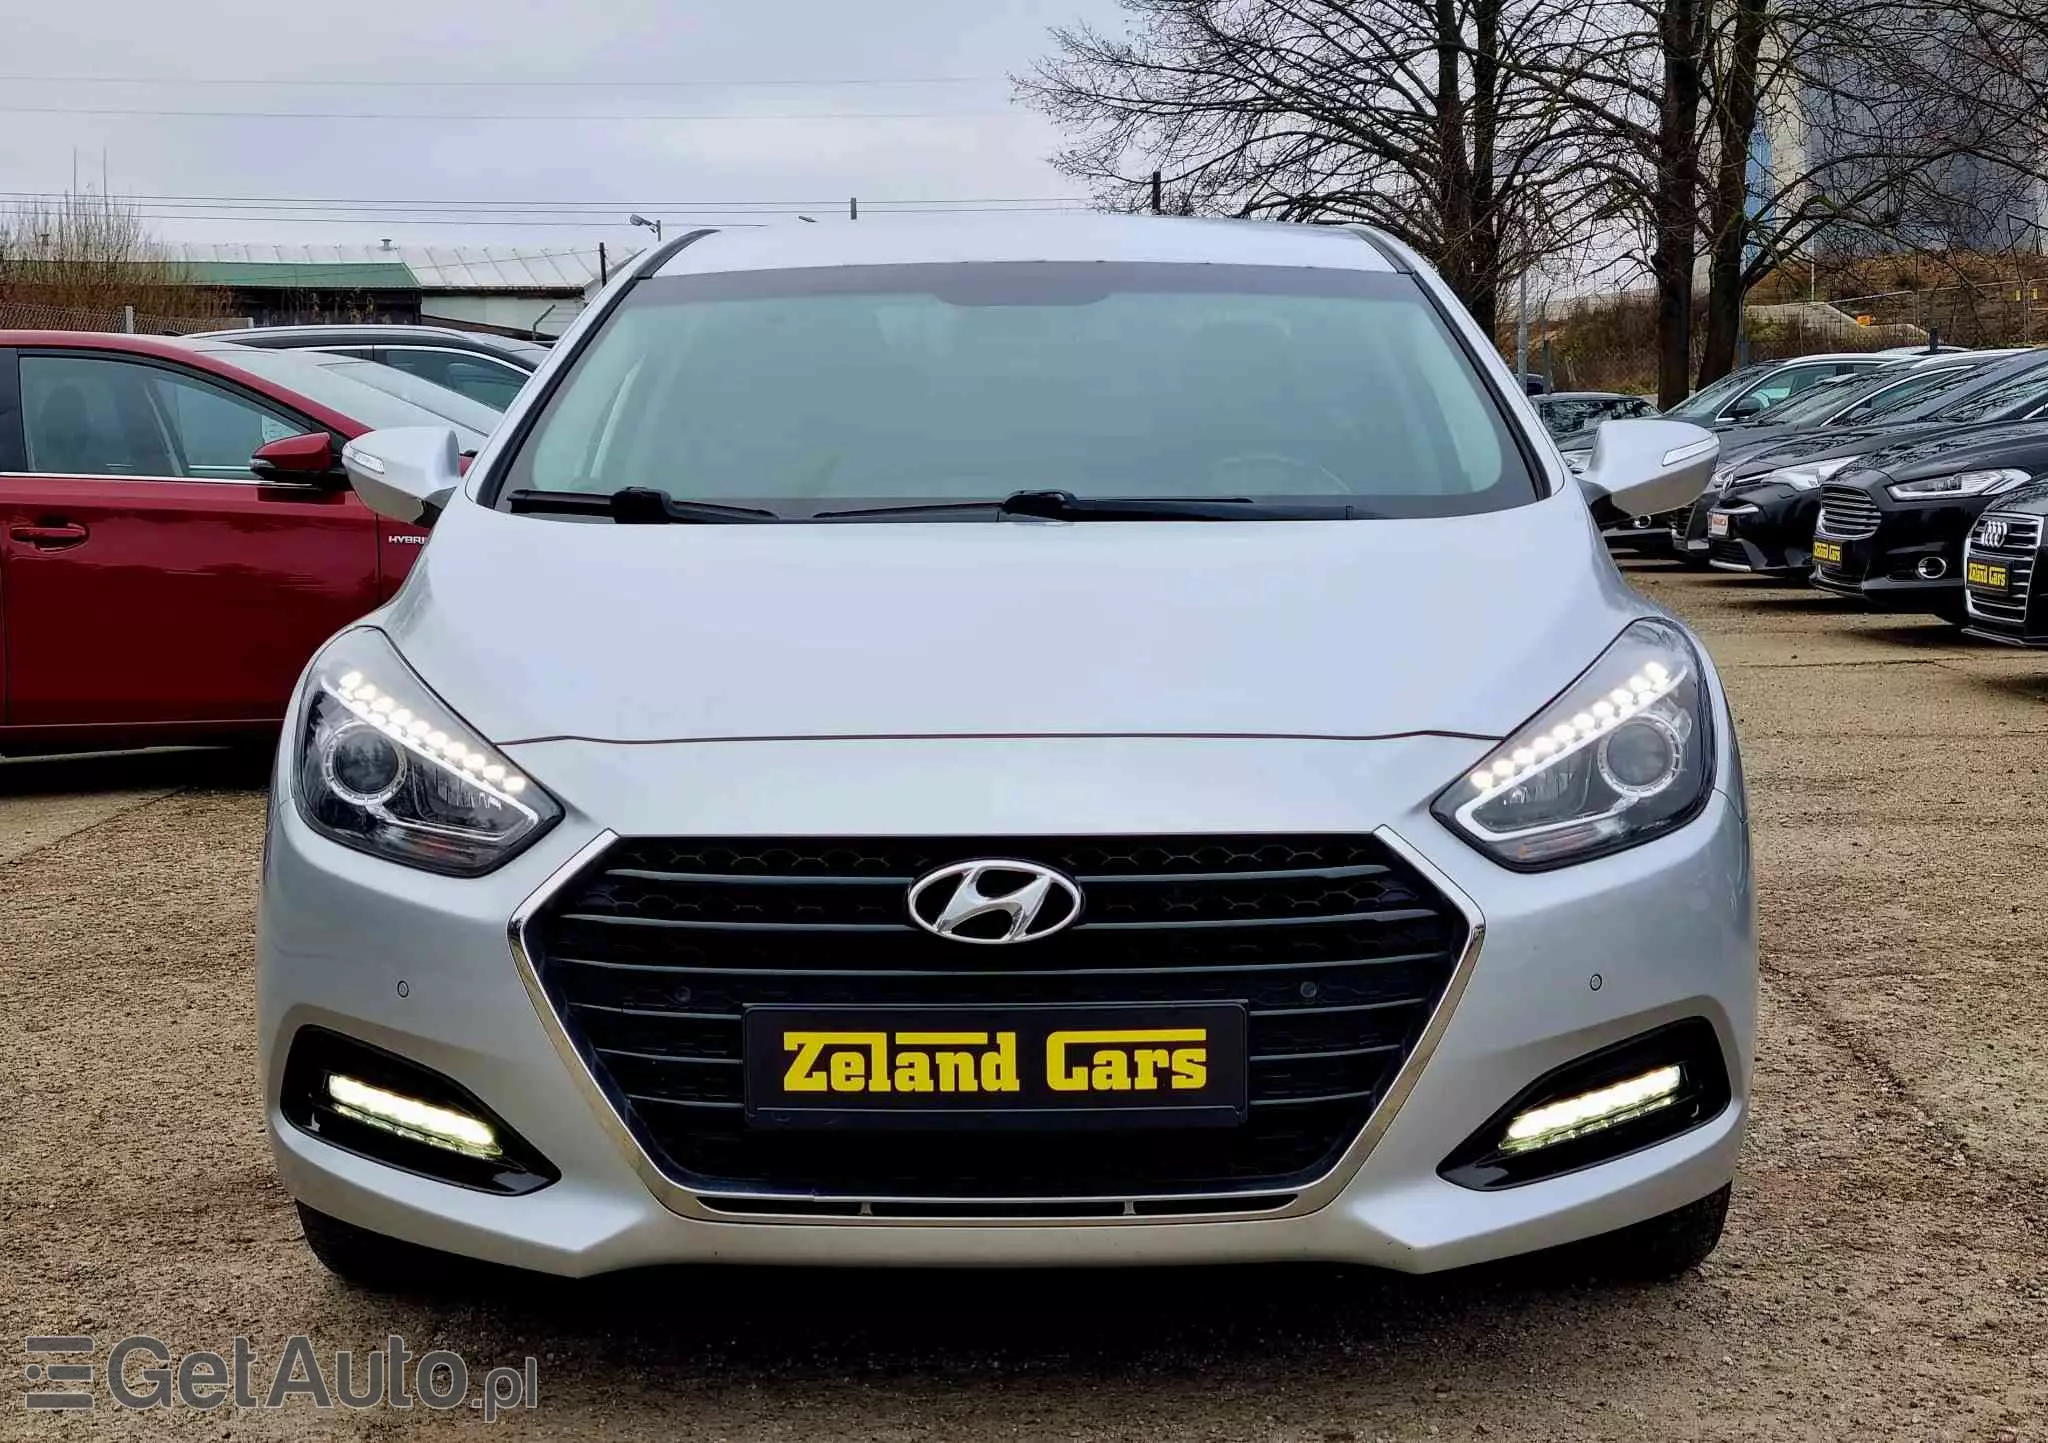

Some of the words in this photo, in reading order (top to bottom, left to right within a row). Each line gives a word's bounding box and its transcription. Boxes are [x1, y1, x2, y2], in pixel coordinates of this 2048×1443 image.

[388, 535, 426, 545] HYBRI
[783, 1031, 1020, 1092] Zeland
[1045, 1028, 1207, 1091] Cars
